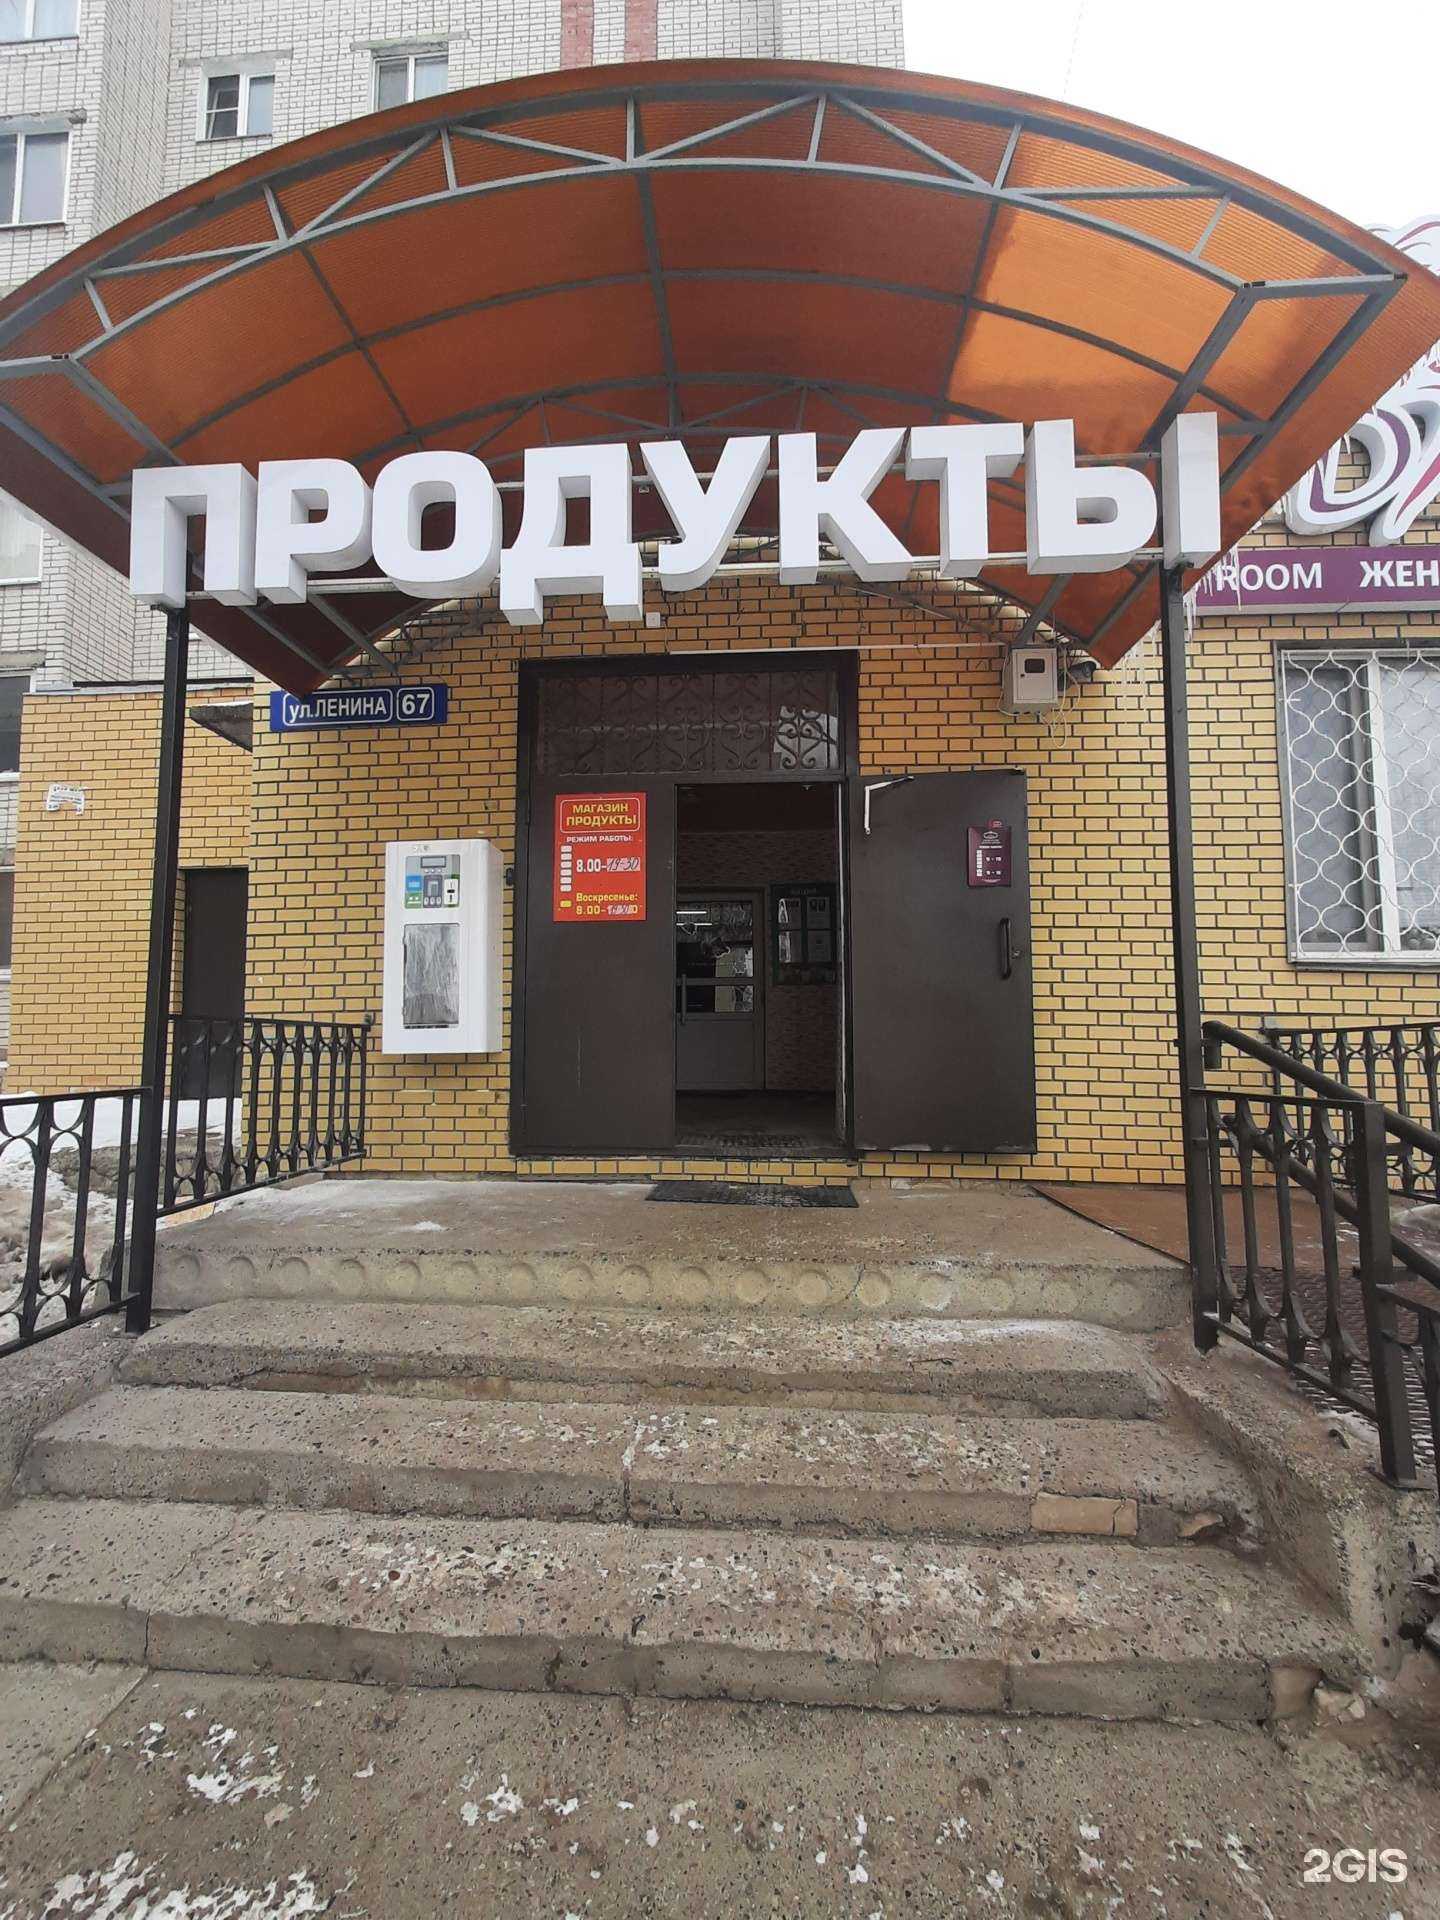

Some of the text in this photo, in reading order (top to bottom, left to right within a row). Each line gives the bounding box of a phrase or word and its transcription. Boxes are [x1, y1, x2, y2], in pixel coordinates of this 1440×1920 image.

[130, 412, 1221, 623] ПРОДУКТЫ
[1359, 559, 1440, 588] ЖЕН
[289, 693, 430, 723] ул.ЛЕНИНА 67
[572, 803, 629, 814] МАГАЗИН
[566, 815, 637, 827] ПРОДУКТЫ
[566, 836, 598, 844] РЕЖИМ
